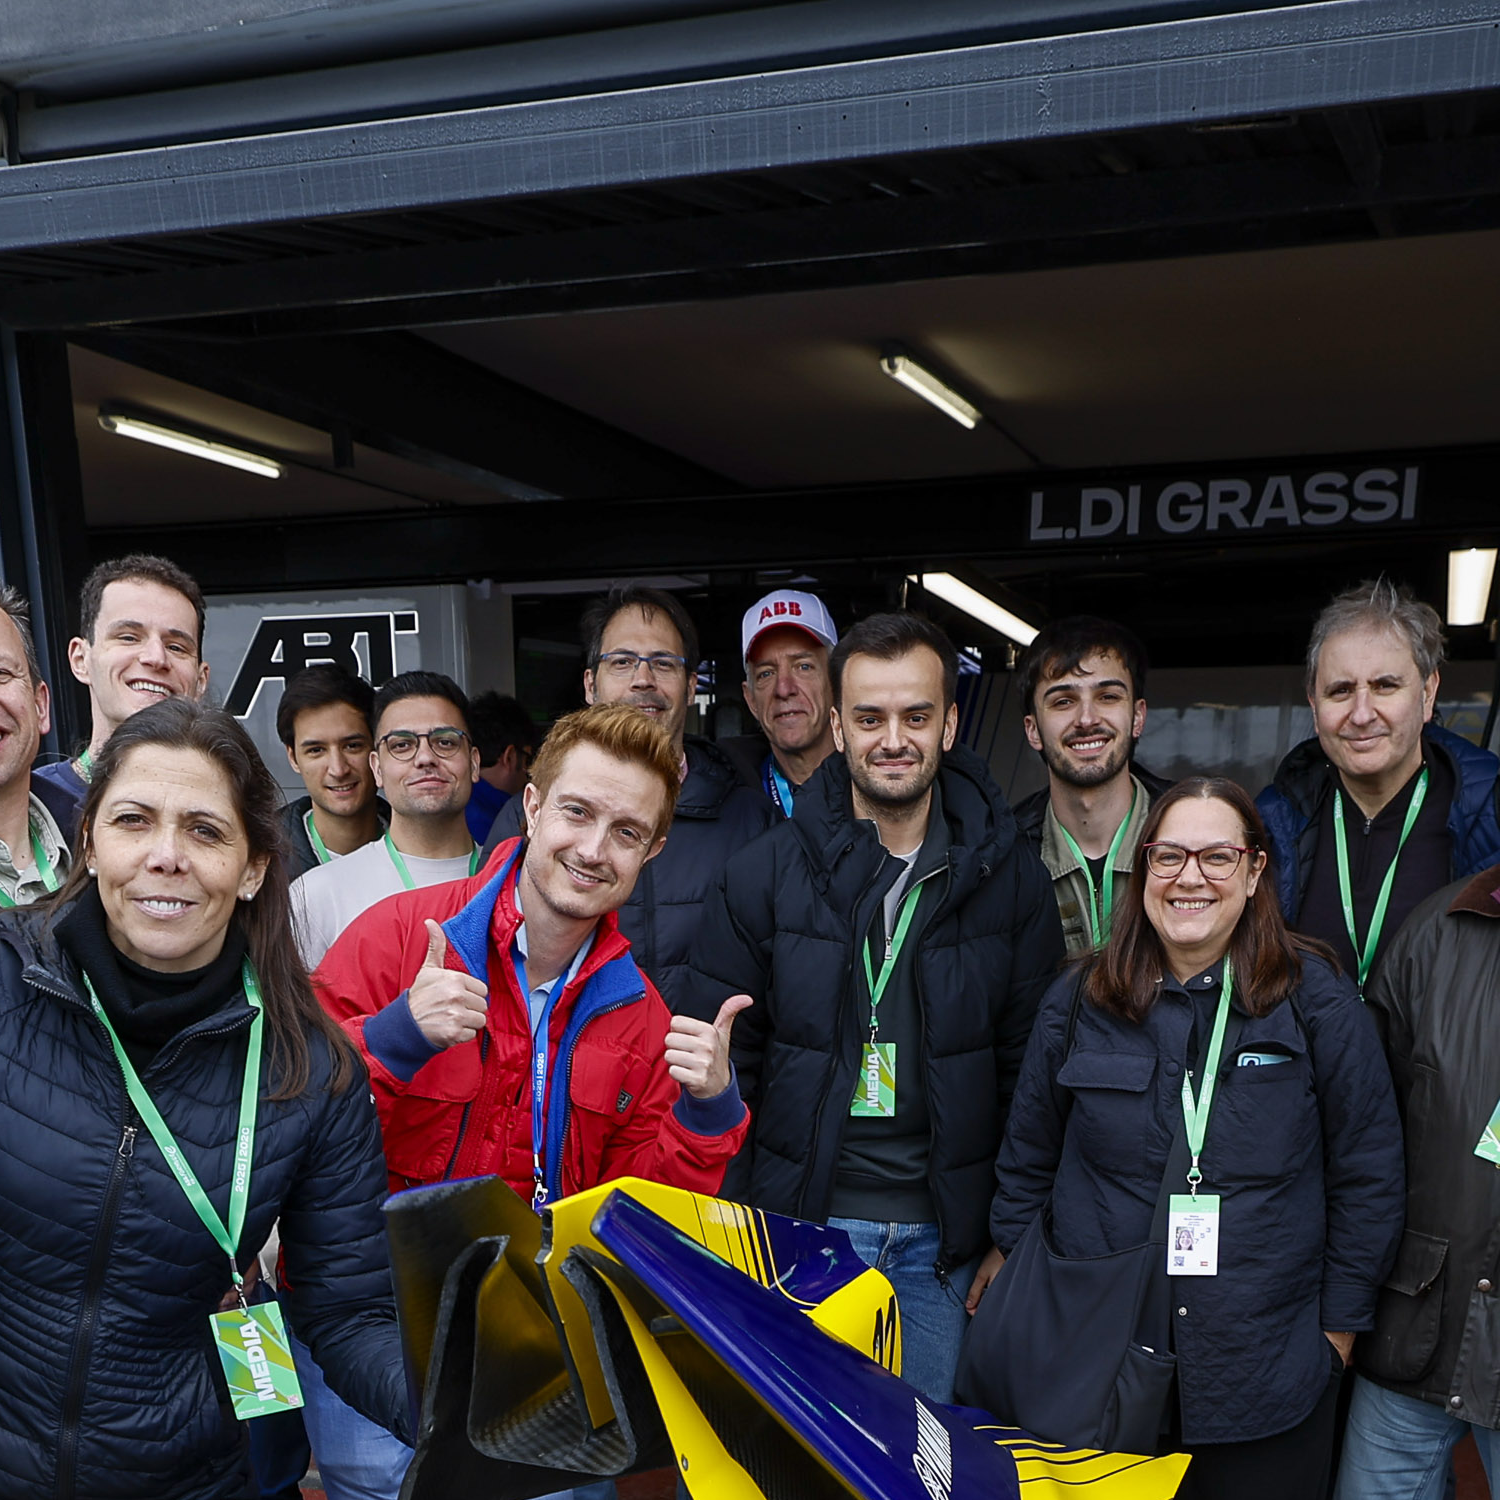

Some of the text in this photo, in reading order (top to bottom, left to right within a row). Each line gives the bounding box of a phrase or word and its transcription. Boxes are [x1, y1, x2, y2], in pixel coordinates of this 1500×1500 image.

[1029, 467, 1419, 541] L.DI GRASSI
[759, 601, 802, 625] ABB
[223, 611, 419, 719] ABT
[867, 1052, 879, 1108] MEDIA
[235, 1165, 247, 1192] 2025
[239, 1319, 277, 1402] MEDIA
